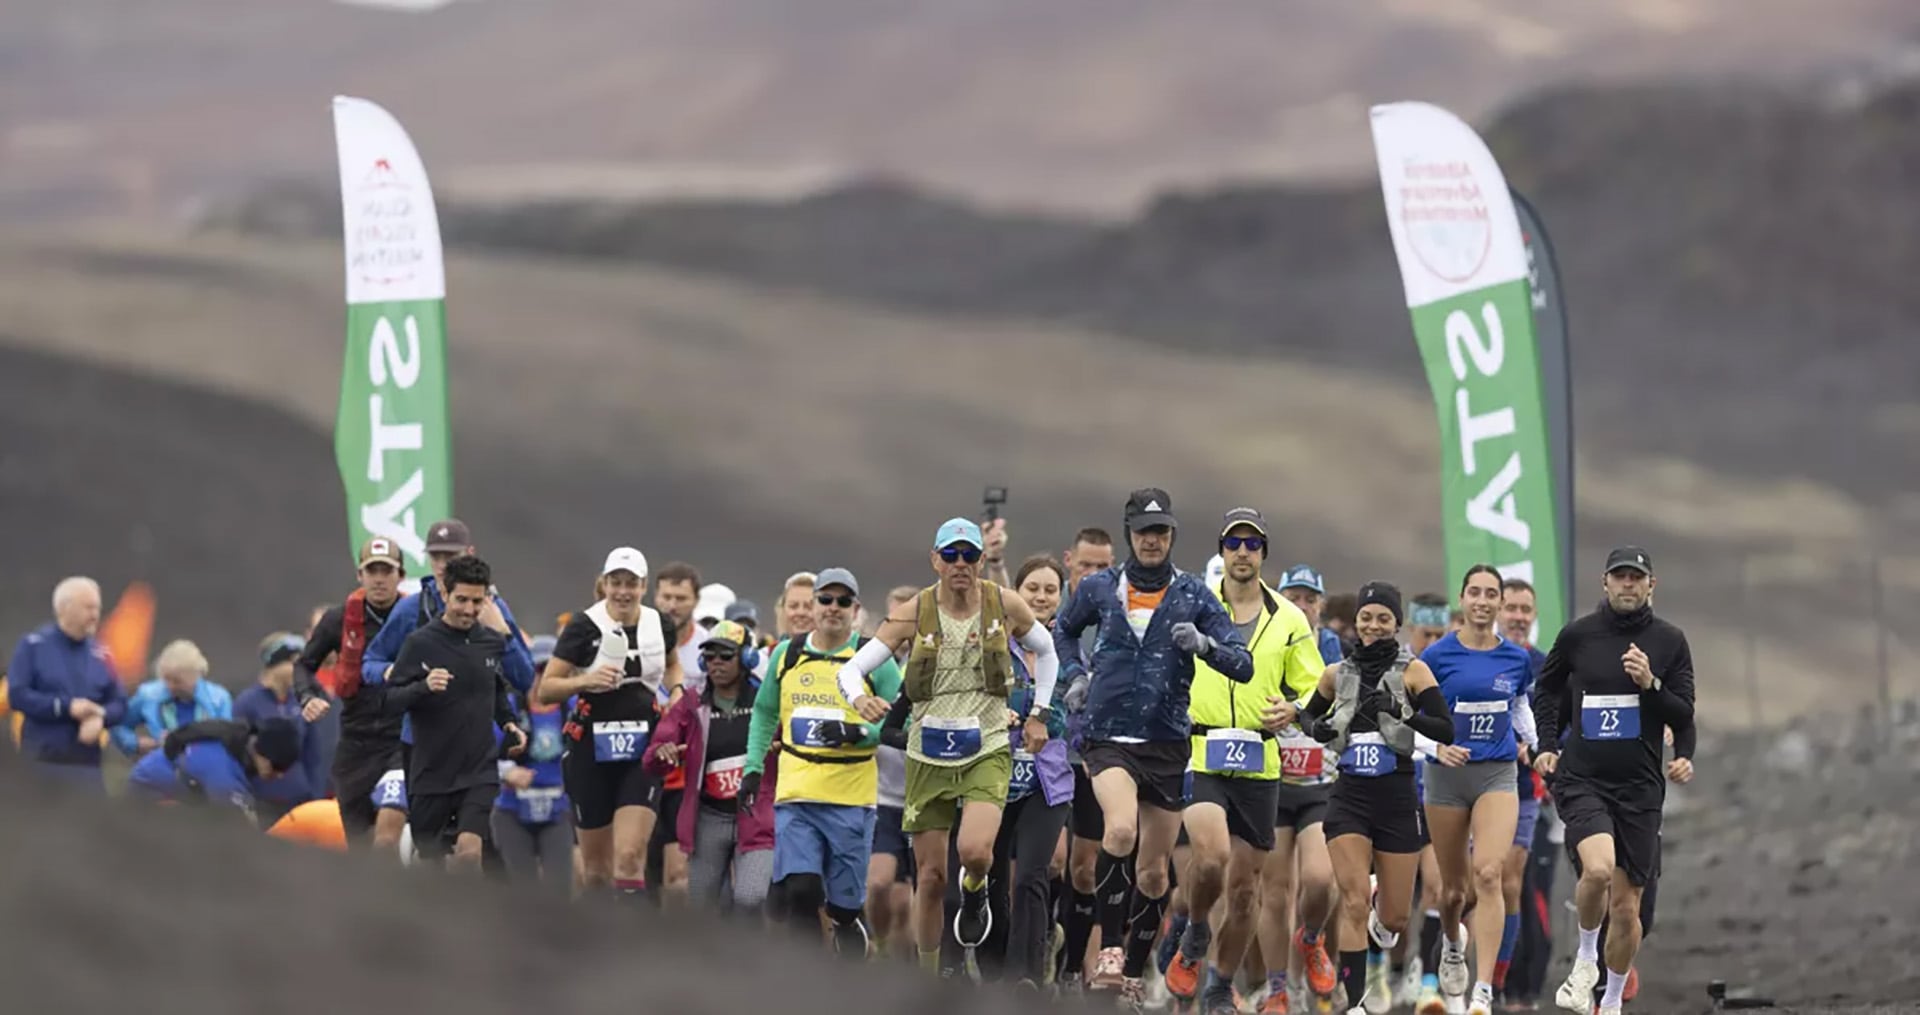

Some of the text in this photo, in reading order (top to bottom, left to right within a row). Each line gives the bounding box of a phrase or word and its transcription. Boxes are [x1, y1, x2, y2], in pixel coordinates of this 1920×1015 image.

[791, 693, 840, 706] BRASIL
[1469, 715, 1495, 734] 122
[1600, 709, 1620, 731] 23
[608, 733, 635, 753] 102
[946, 731, 956, 750] 5
[1225, 741, 1246, 762] 26
[1283, 750, 1311, 768] 207
[1354, 745, 1380, 766] 118
[716, 769, 742, 791] 316
